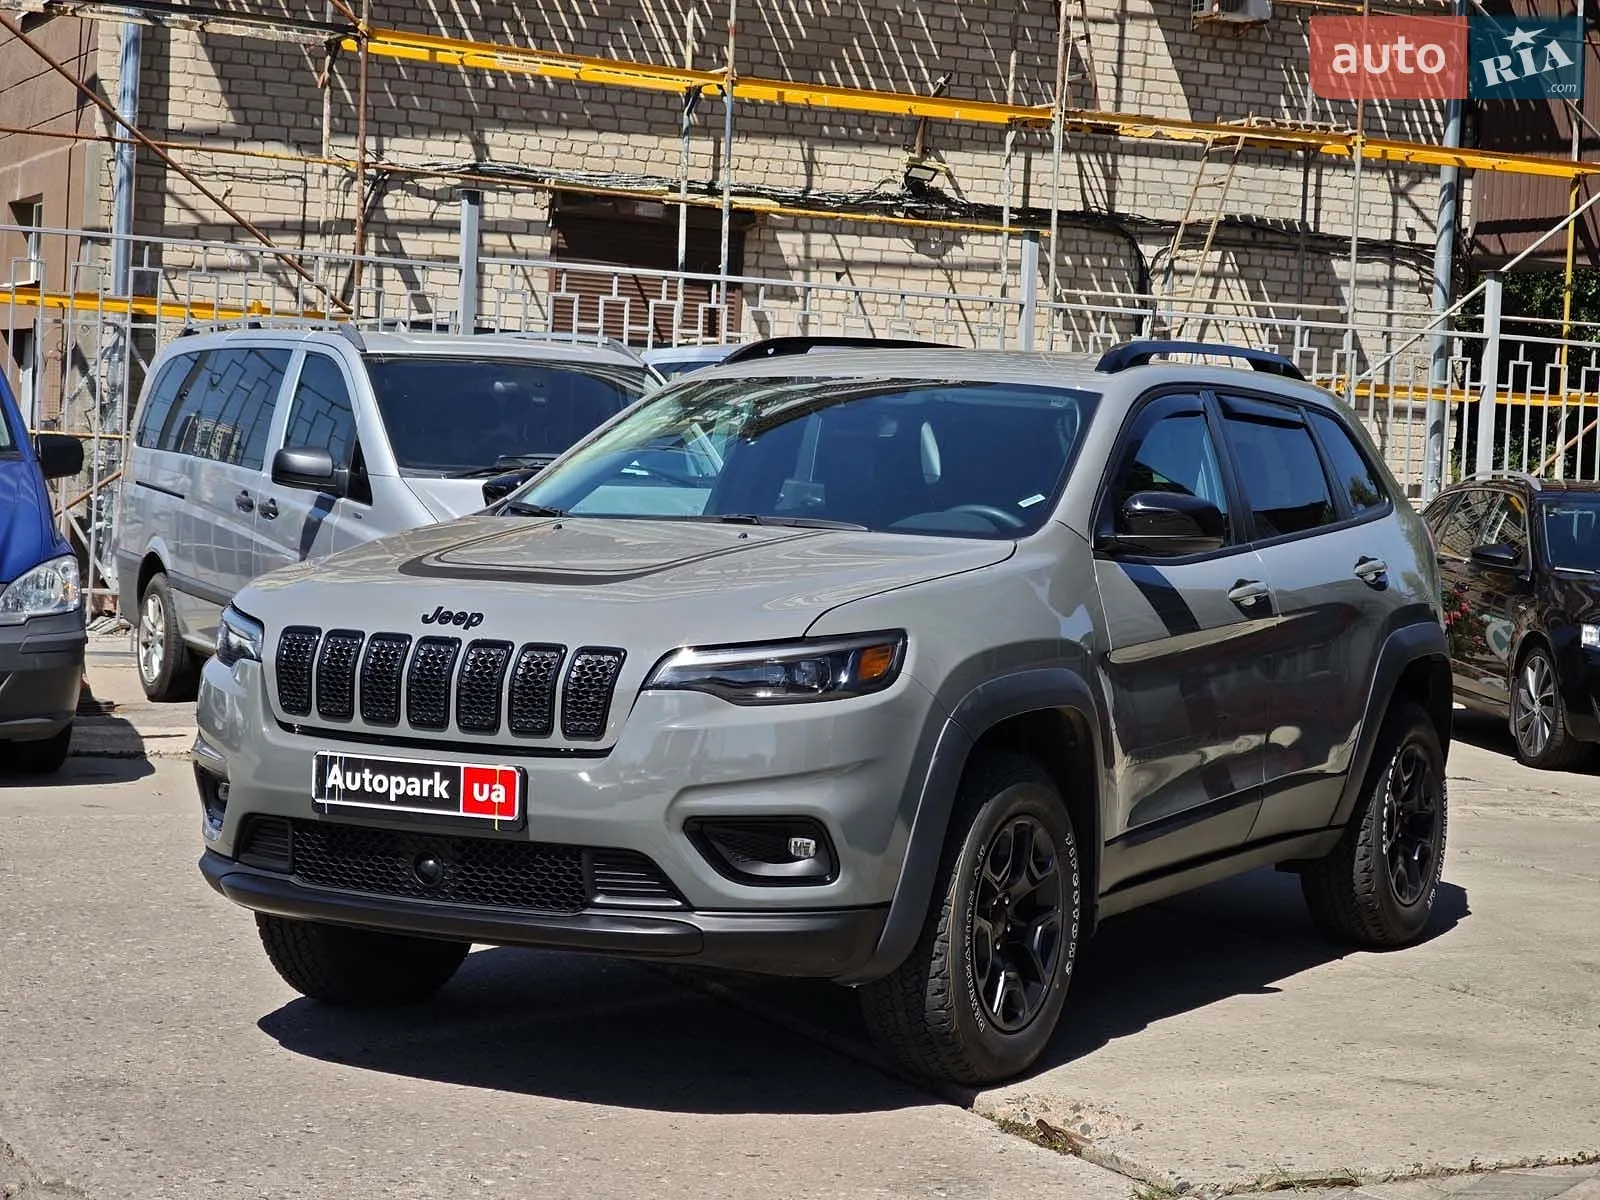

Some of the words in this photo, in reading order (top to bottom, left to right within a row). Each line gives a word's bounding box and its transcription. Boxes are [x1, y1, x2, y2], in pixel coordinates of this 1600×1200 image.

[421, 606, 484, 630] Jeep
[326, 765, 450, 801] Autopark
[472, 783, 506, 803] ua
